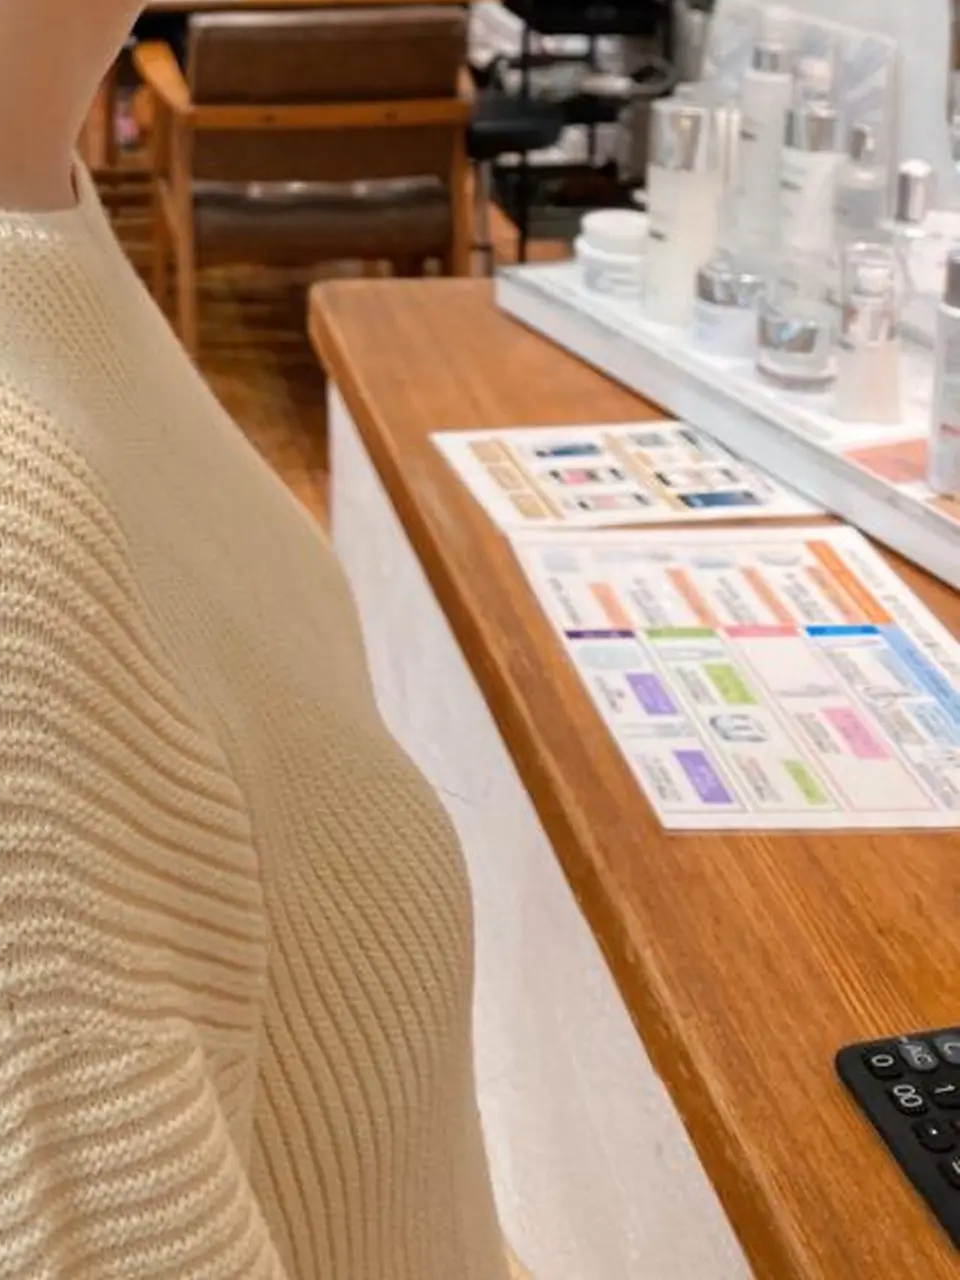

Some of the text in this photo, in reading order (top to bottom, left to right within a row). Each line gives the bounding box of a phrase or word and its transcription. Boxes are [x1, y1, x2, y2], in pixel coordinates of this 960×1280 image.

[871, 1053, 894, 1067] 0
[893, 1084, 923, 1108] 00
[934, 1084, 956, 1095] 1
